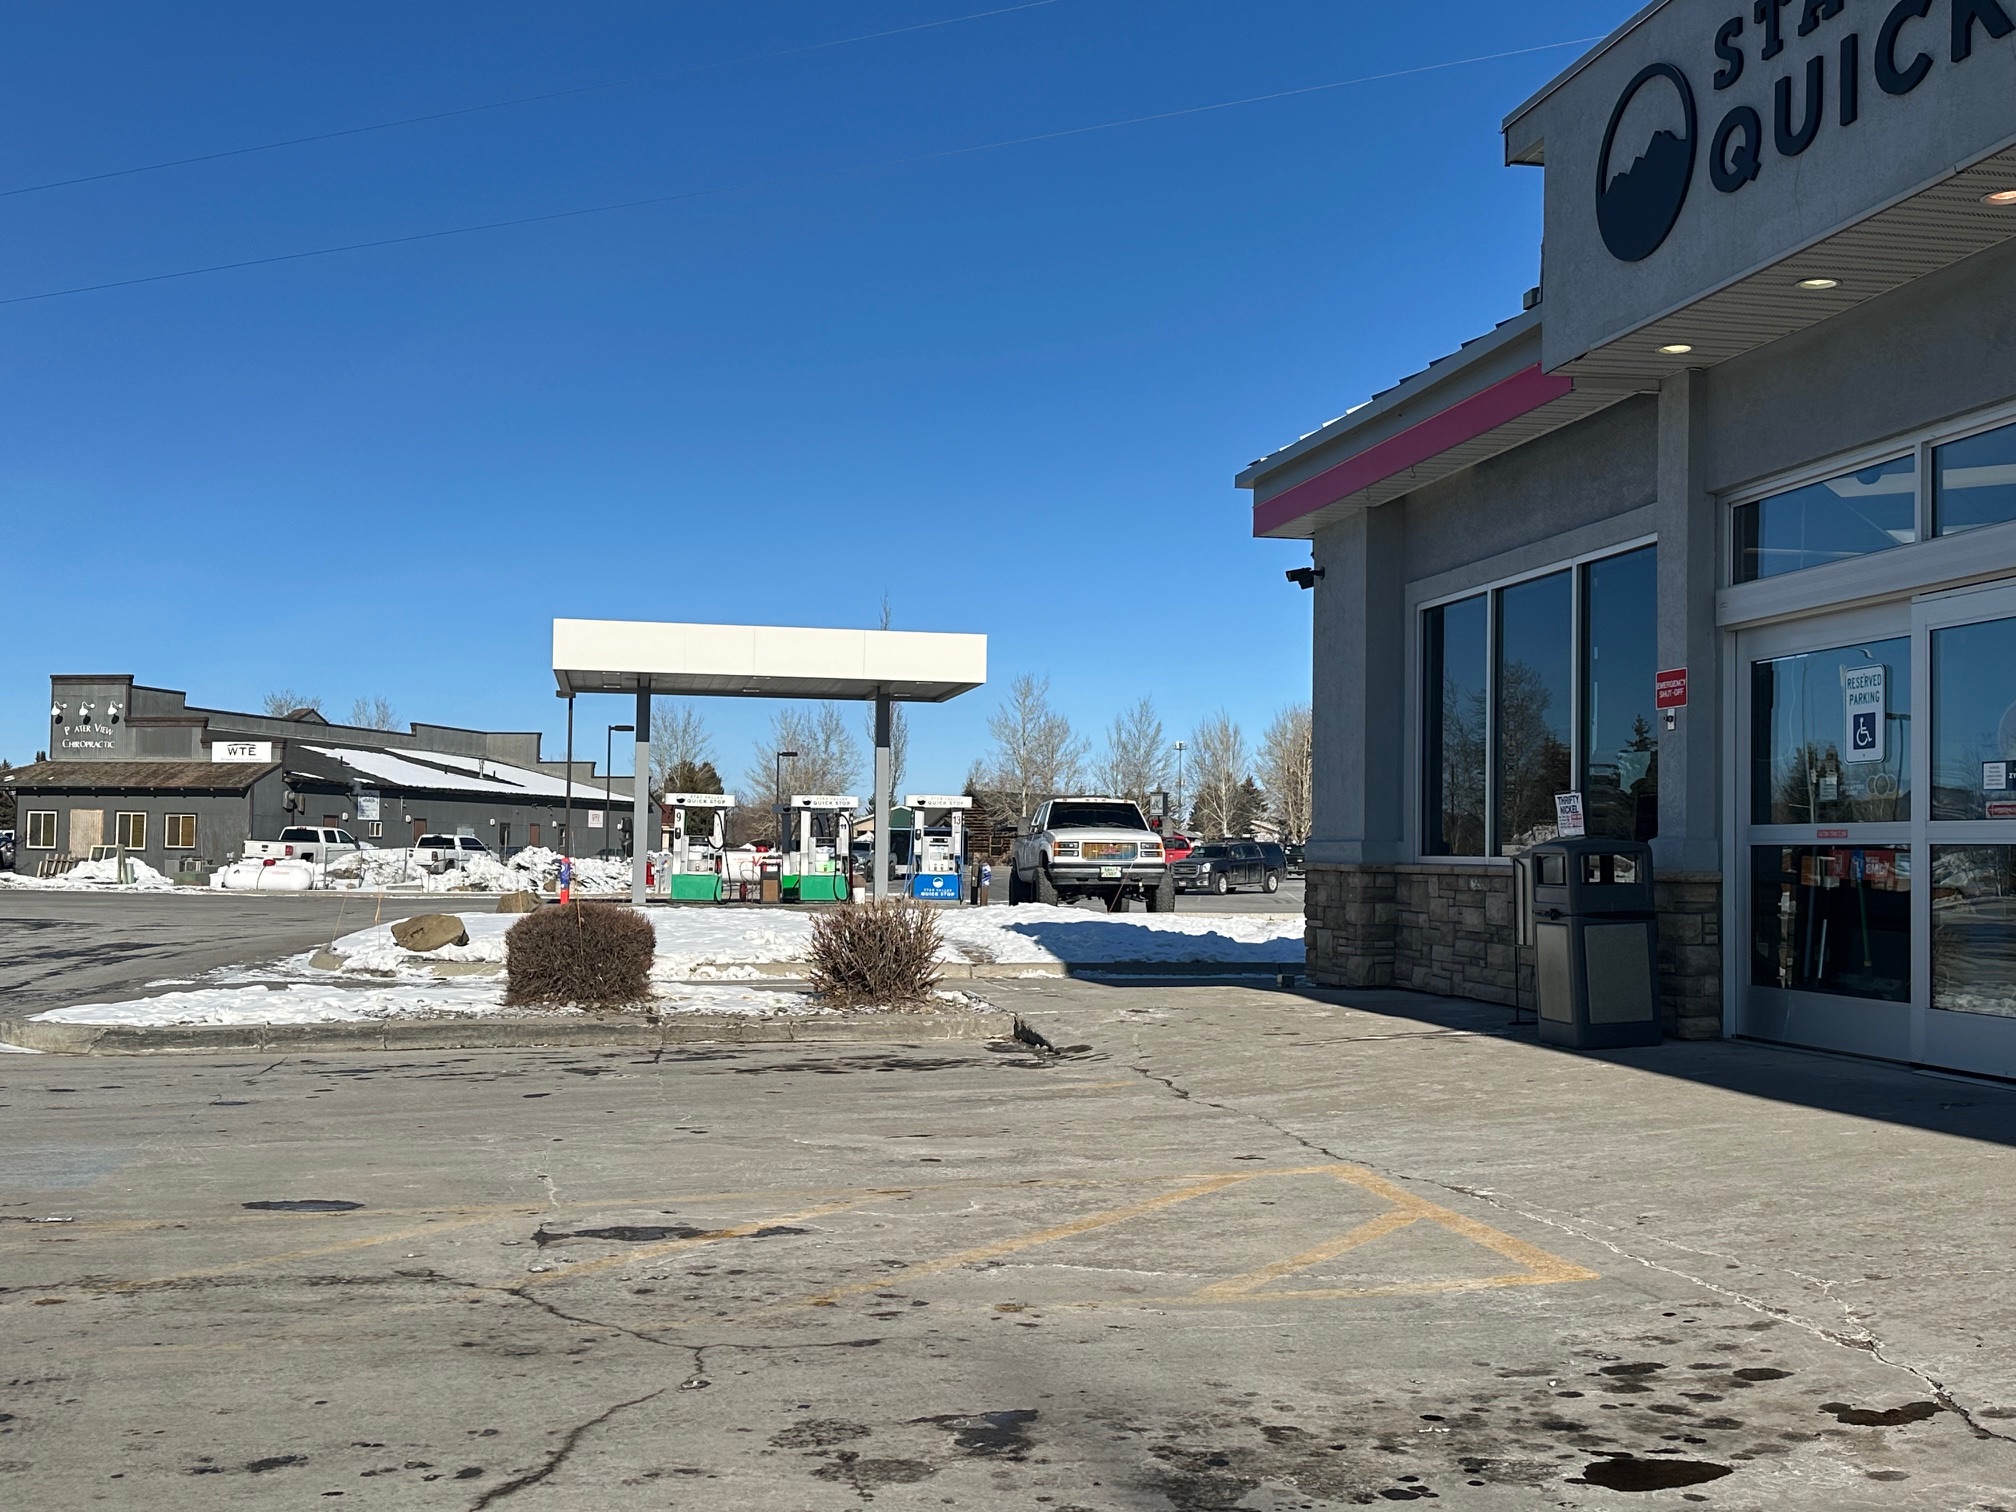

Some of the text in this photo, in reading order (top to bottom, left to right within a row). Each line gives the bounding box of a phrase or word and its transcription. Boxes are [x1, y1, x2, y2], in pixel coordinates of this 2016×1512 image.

[1657, 678, 1686, 690] EMERGENCY
[1847, 674, 1882, 690] RESERVED
[1659, 688, 1684, 698] SHUT-OFF
[1849, 691, 1880, 706] PARKING
[94, 723, 114, 736] VIEW
[62, 738, 115, 749] CHIROPRACTIC
[227, 747, 257, 756] WTE
[1557, 794, 1580, 806] THRIFTY
[1559, 805, 1579, 815] NICKEL
[676, 812, 682, 822] 9
[953, 815, 961, 825] 13
